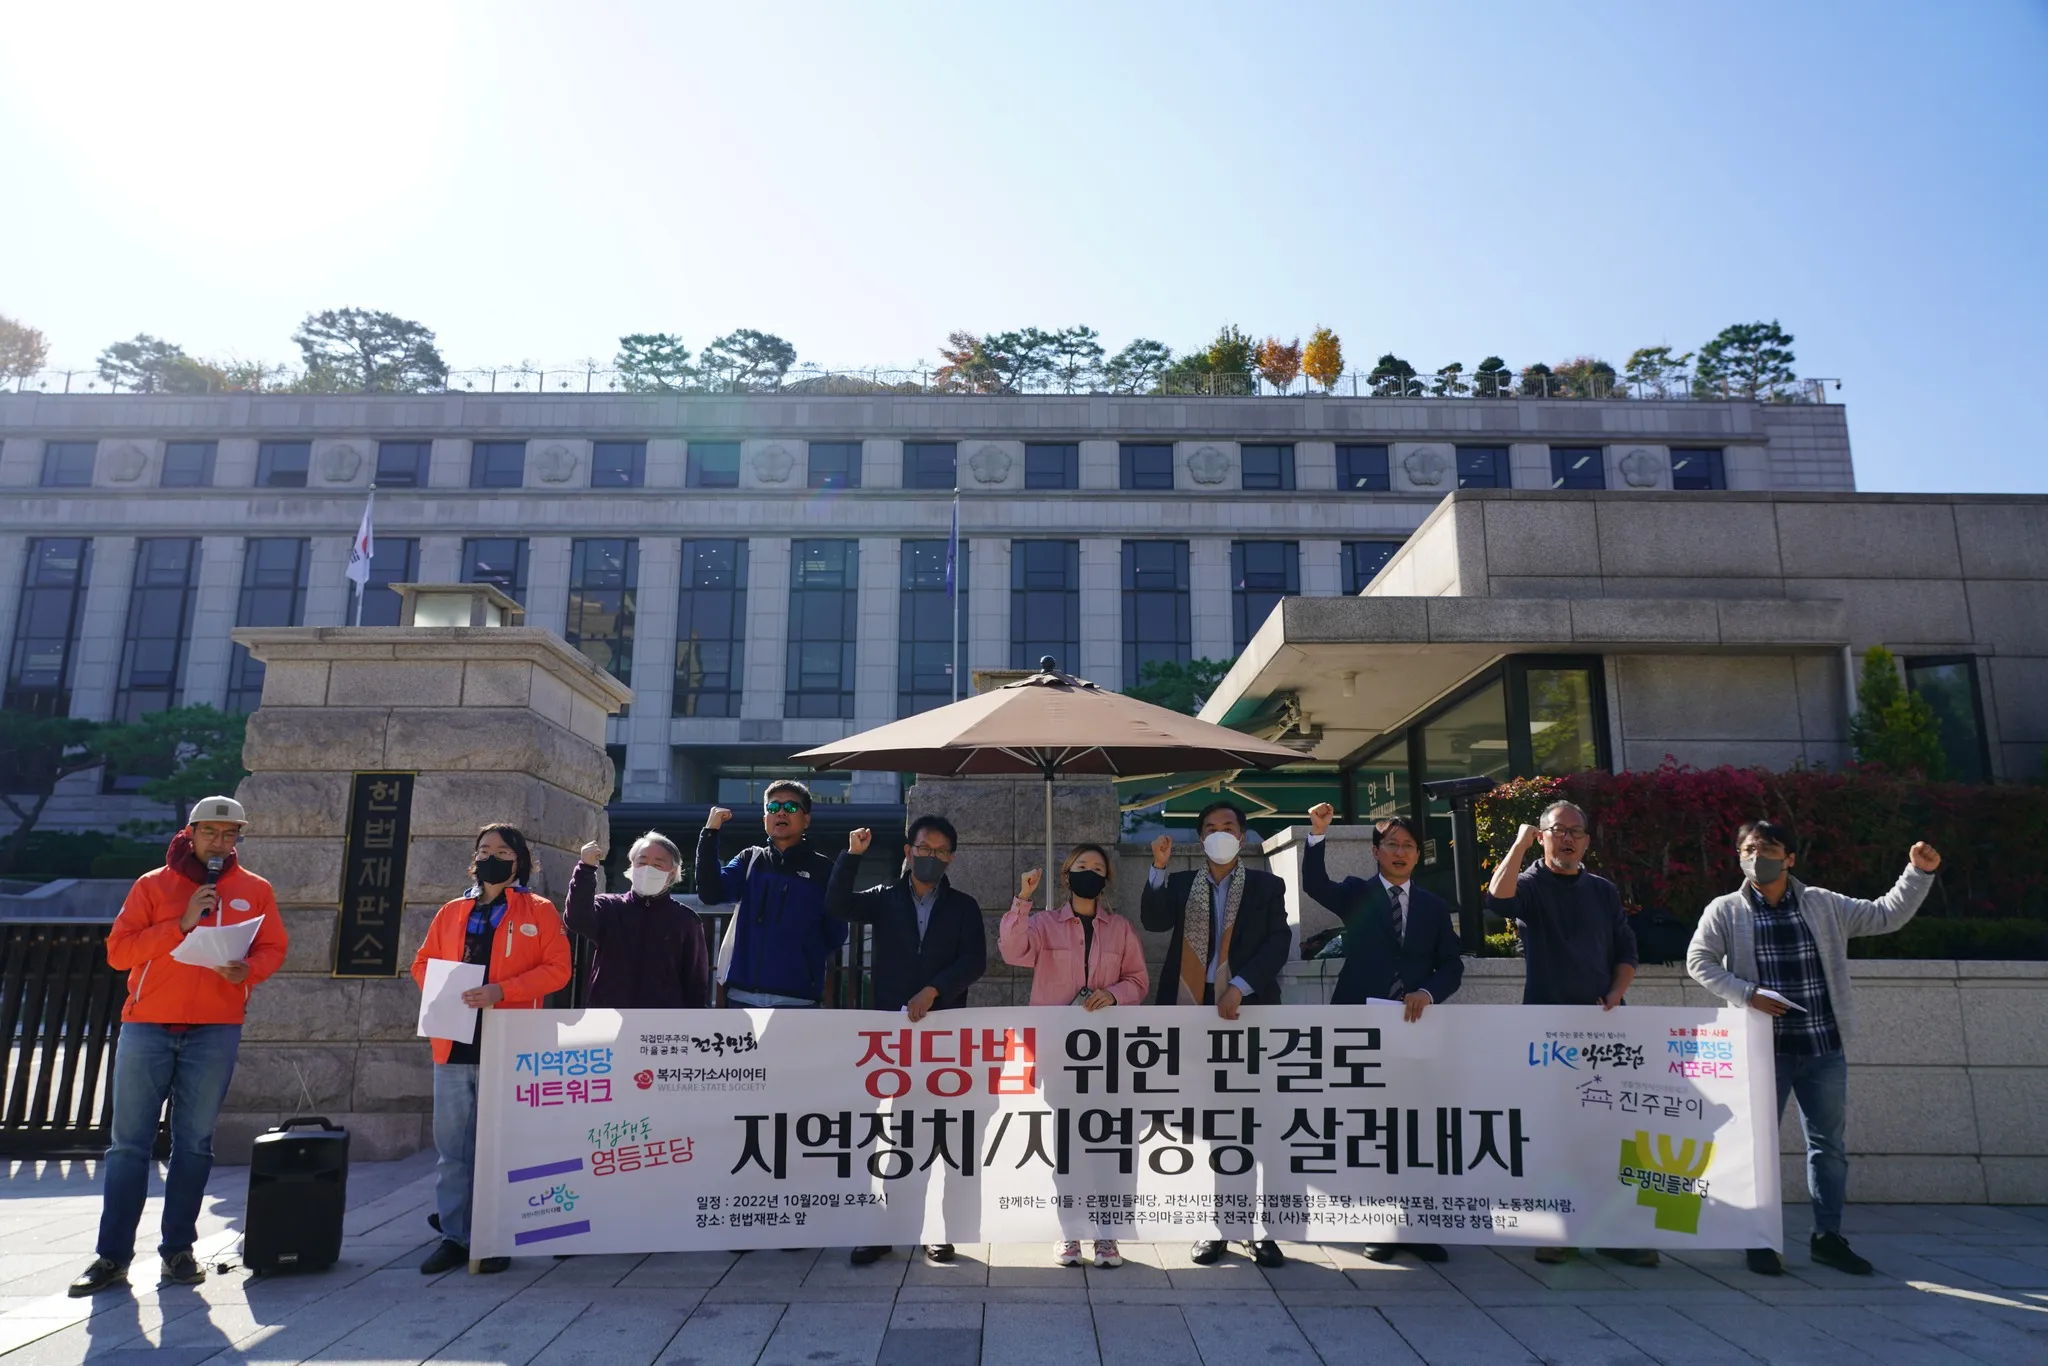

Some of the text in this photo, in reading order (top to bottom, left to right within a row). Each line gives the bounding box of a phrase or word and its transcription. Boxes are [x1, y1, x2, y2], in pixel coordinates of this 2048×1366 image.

[351, 780, 400, 965] 헌법재판소
[640, 1034, 689, 1044] 직접민주주의
[640, 1045, 689, 1056] 마을공화국
[1667, 1040, 1733, 1060] 지역정당
[515, 1048, 614, 1077] 지역정당
[855, 1026, 1386, 1099] 정당법 위헌 판결로
[1529, 1041, 1646, 1070] Like 익산포럼
[657, 1068, 767, 1082] 복지국가소사이어티
[1668, 1061, 1734, 1079] 서포터즈
[516, 1078, 613, 1107] 네트워크
[657, 1083, 767, 1092] WELFARE STATE SOCIETY
[1619, 1091, 1703, 1120] 진주같이
[588, 1117, 653, 1149] 직접행동
[730, 1107, 1530, 1180] 지역정치/지역정당 살려내자
[591, 1137, 695, 1177] 영등포당
[1620, 1167, 1710, 1198] 은평민들레당
[697, 1196, 721, 1210] 일정
[733, 1195, 779, 1208] 2022년
[784, 1194, 840, 1208] 10월20일
[844, 1193, 889, 1206] 오후2시
[999, 1196, 1047, 1209] 함께하는
[1051, 1195, 1075, 1209] 이들
[1085, 1194, 1160, 1209] 은평민들레당,
[1165, 1194, 1252, 1209] 과천시민정치당,
[1257, 1194, 1355, 1209] 직접행동영등포당,
[1359, 1195, 1438, 1210] Like익산포럼,
[1442, 1196, 1495, 1211] 진주같이,
[1499, 1198, 1576, 1213] 노동정치사람,
[696, 1211, 807, 1228] 장소: 헌법재판소 앞
[1088, 1211, 1519, 1229] 직접민주주의마을공화국 전국민회, (사)복지국가소사이어티, 지역정당 창당학교
